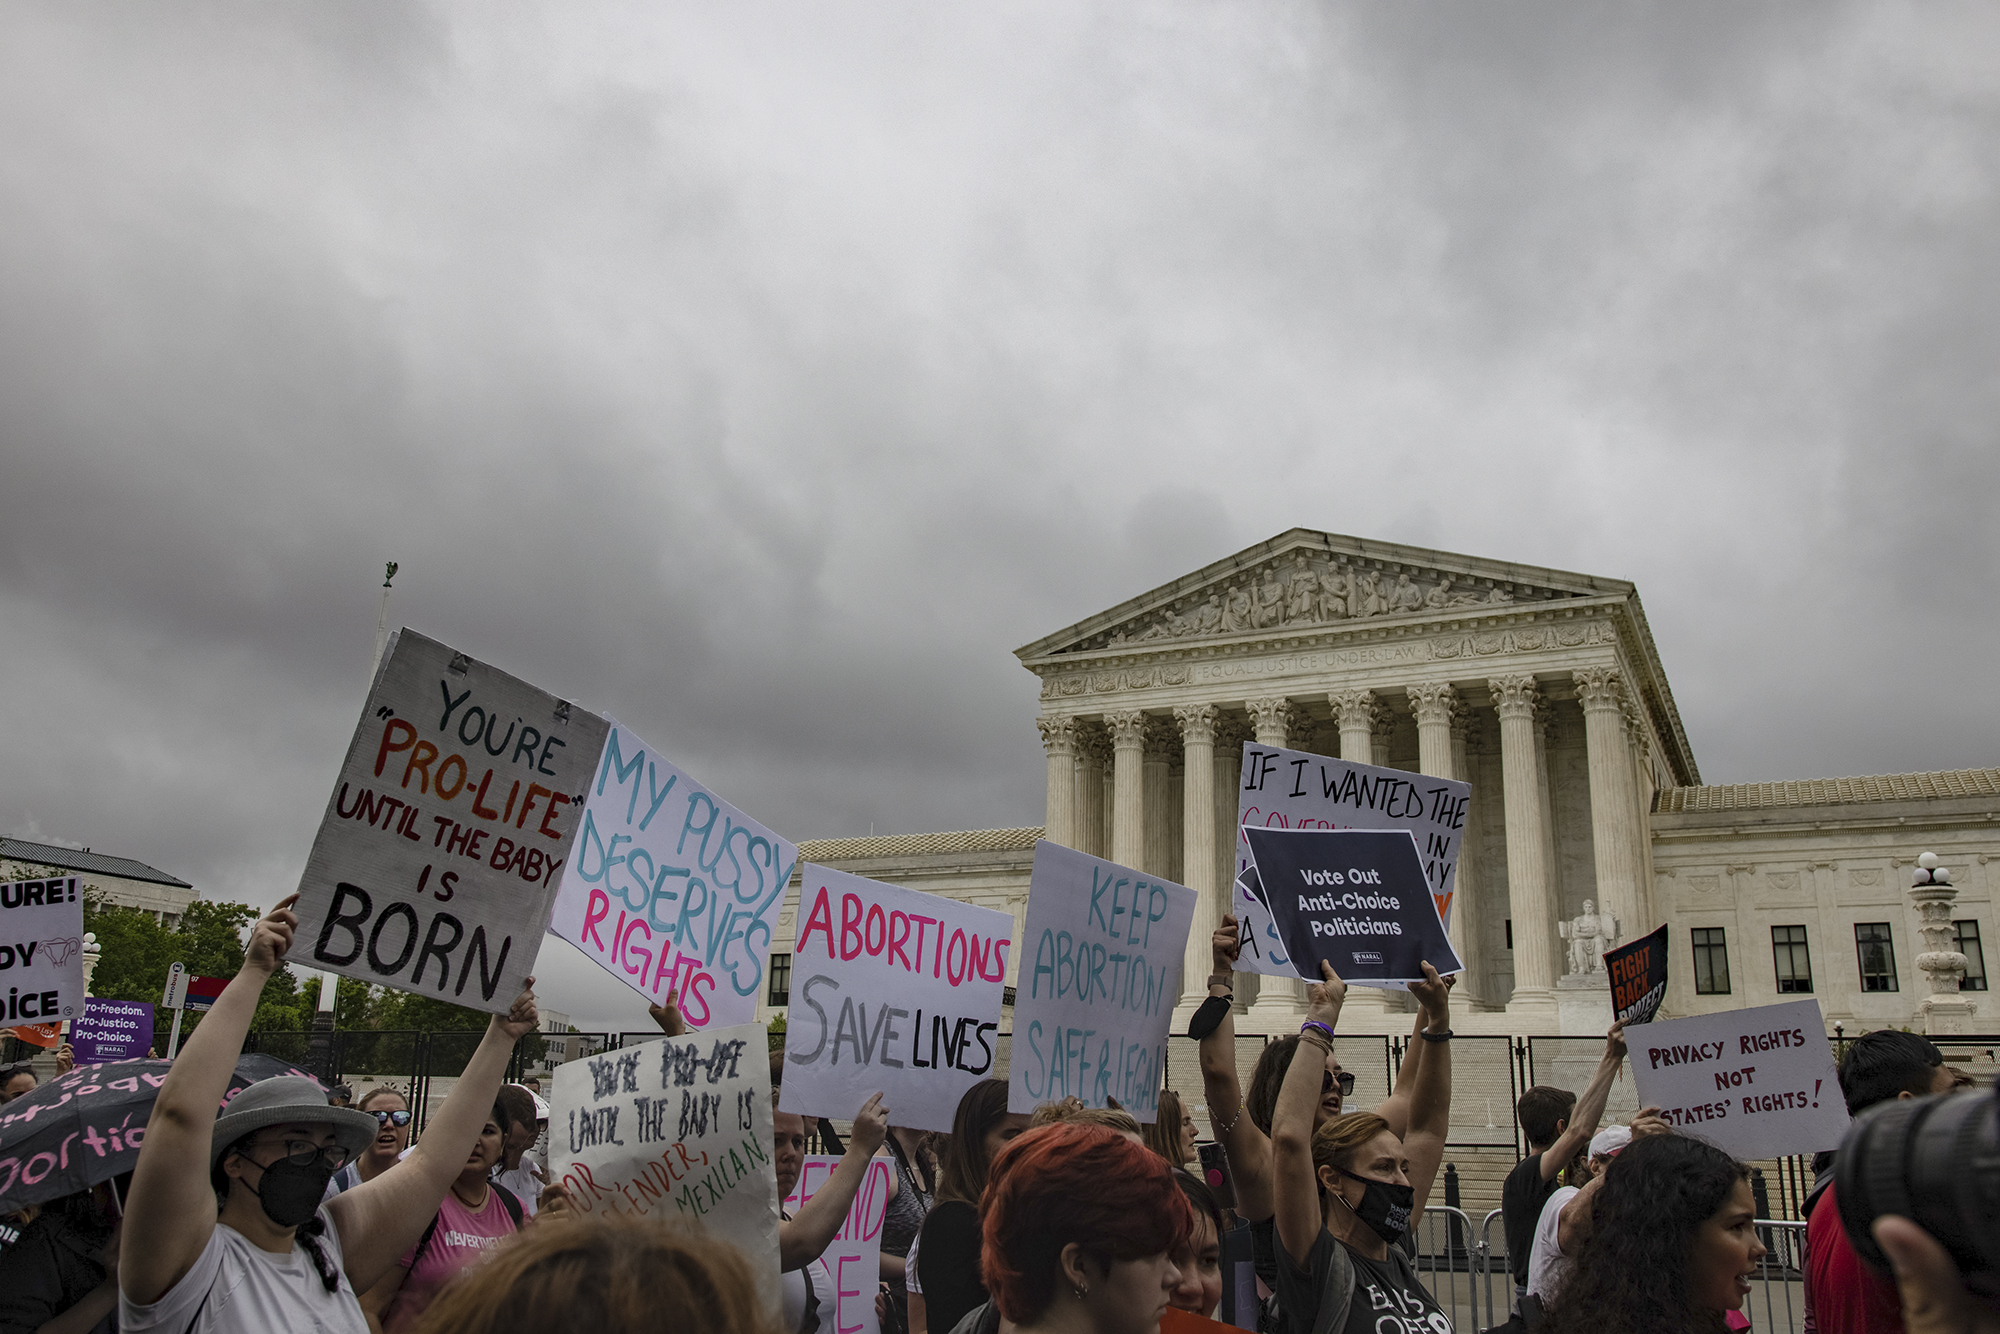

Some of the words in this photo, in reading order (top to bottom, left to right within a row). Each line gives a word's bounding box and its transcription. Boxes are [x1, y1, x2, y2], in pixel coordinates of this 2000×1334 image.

[1202, 662, 1253, 678] EQUAL
[1256, 654, 1318, 673] JUSTICE
[1325, 650, 1378, 666] UNDER
[1385, 645, 1416, 660] LAW
[439, 679, 566, 776] YOU'RE
[1244, 752, 1280, 791] IF
[1289, 759, 1309, 798] I
[1321, 765, 1424, 818] WANTED
[1427, 787, 1470, 830] THE
[336, 782, 421, 841] UNTIL
[434, 815, 490, 860] THE
[489, 836, 563, 889] BABY
[597, 727, 677, 831] MY
[677, 791, 795, 920] PUSSY
[1426, 832, 1451, 859] IN
[416, 864, 459, 902] IS
[577, 808, 770, 996] DESERVES
[1298, 892, 1401, 912] Anti-Choice
[1299, 869, 1345, 886] Vote
[1348, 868, 1382, 885] Out
[1088, 865, 1168, 949] KEEP
[1310, 916, 1402, 938] Politicians
[313, 881, 512, 1002] BORN
[581, 888, 716, 1027] RIGHTS
[797, 886, 1011, 988] ABORTIONS
[1612, 946, 1650, 985] FIGHT
[167, 974, 178, 1006] metrobus
[1032, 928, 1166, 1017] ABORTION
[76, 1030, 135, 1043] Pro-Choice.
[77, 1017, 139, 1030] Pro-Justice.
[86, 1003, 146, 1017] ro-Freedom.
[788, 974, 909, 1069] SAVE
[913, 1009, 998, 1076] LIVES
[1025, 1020, 1096, 1107] SAFE
[1648, 1041, 1724, 1070] PRIVACY
[1739, 1028, 1806, 1055] RIGHTS
[1660, 1099, 1732, 1127] STATES'
[1742, 1079, 1822, 1115] RIGHTS!
[1714, 1066, 1756, 1091] NOT
[569, 1105, 624, 1154] UNTIL
[634, 1096, 668, 1143] THE
[678, 1088, 722, 1143] BABY
[737, 1086, 756, 1131] IS
[675, 1131, 770, 1218] MEXICAN,
